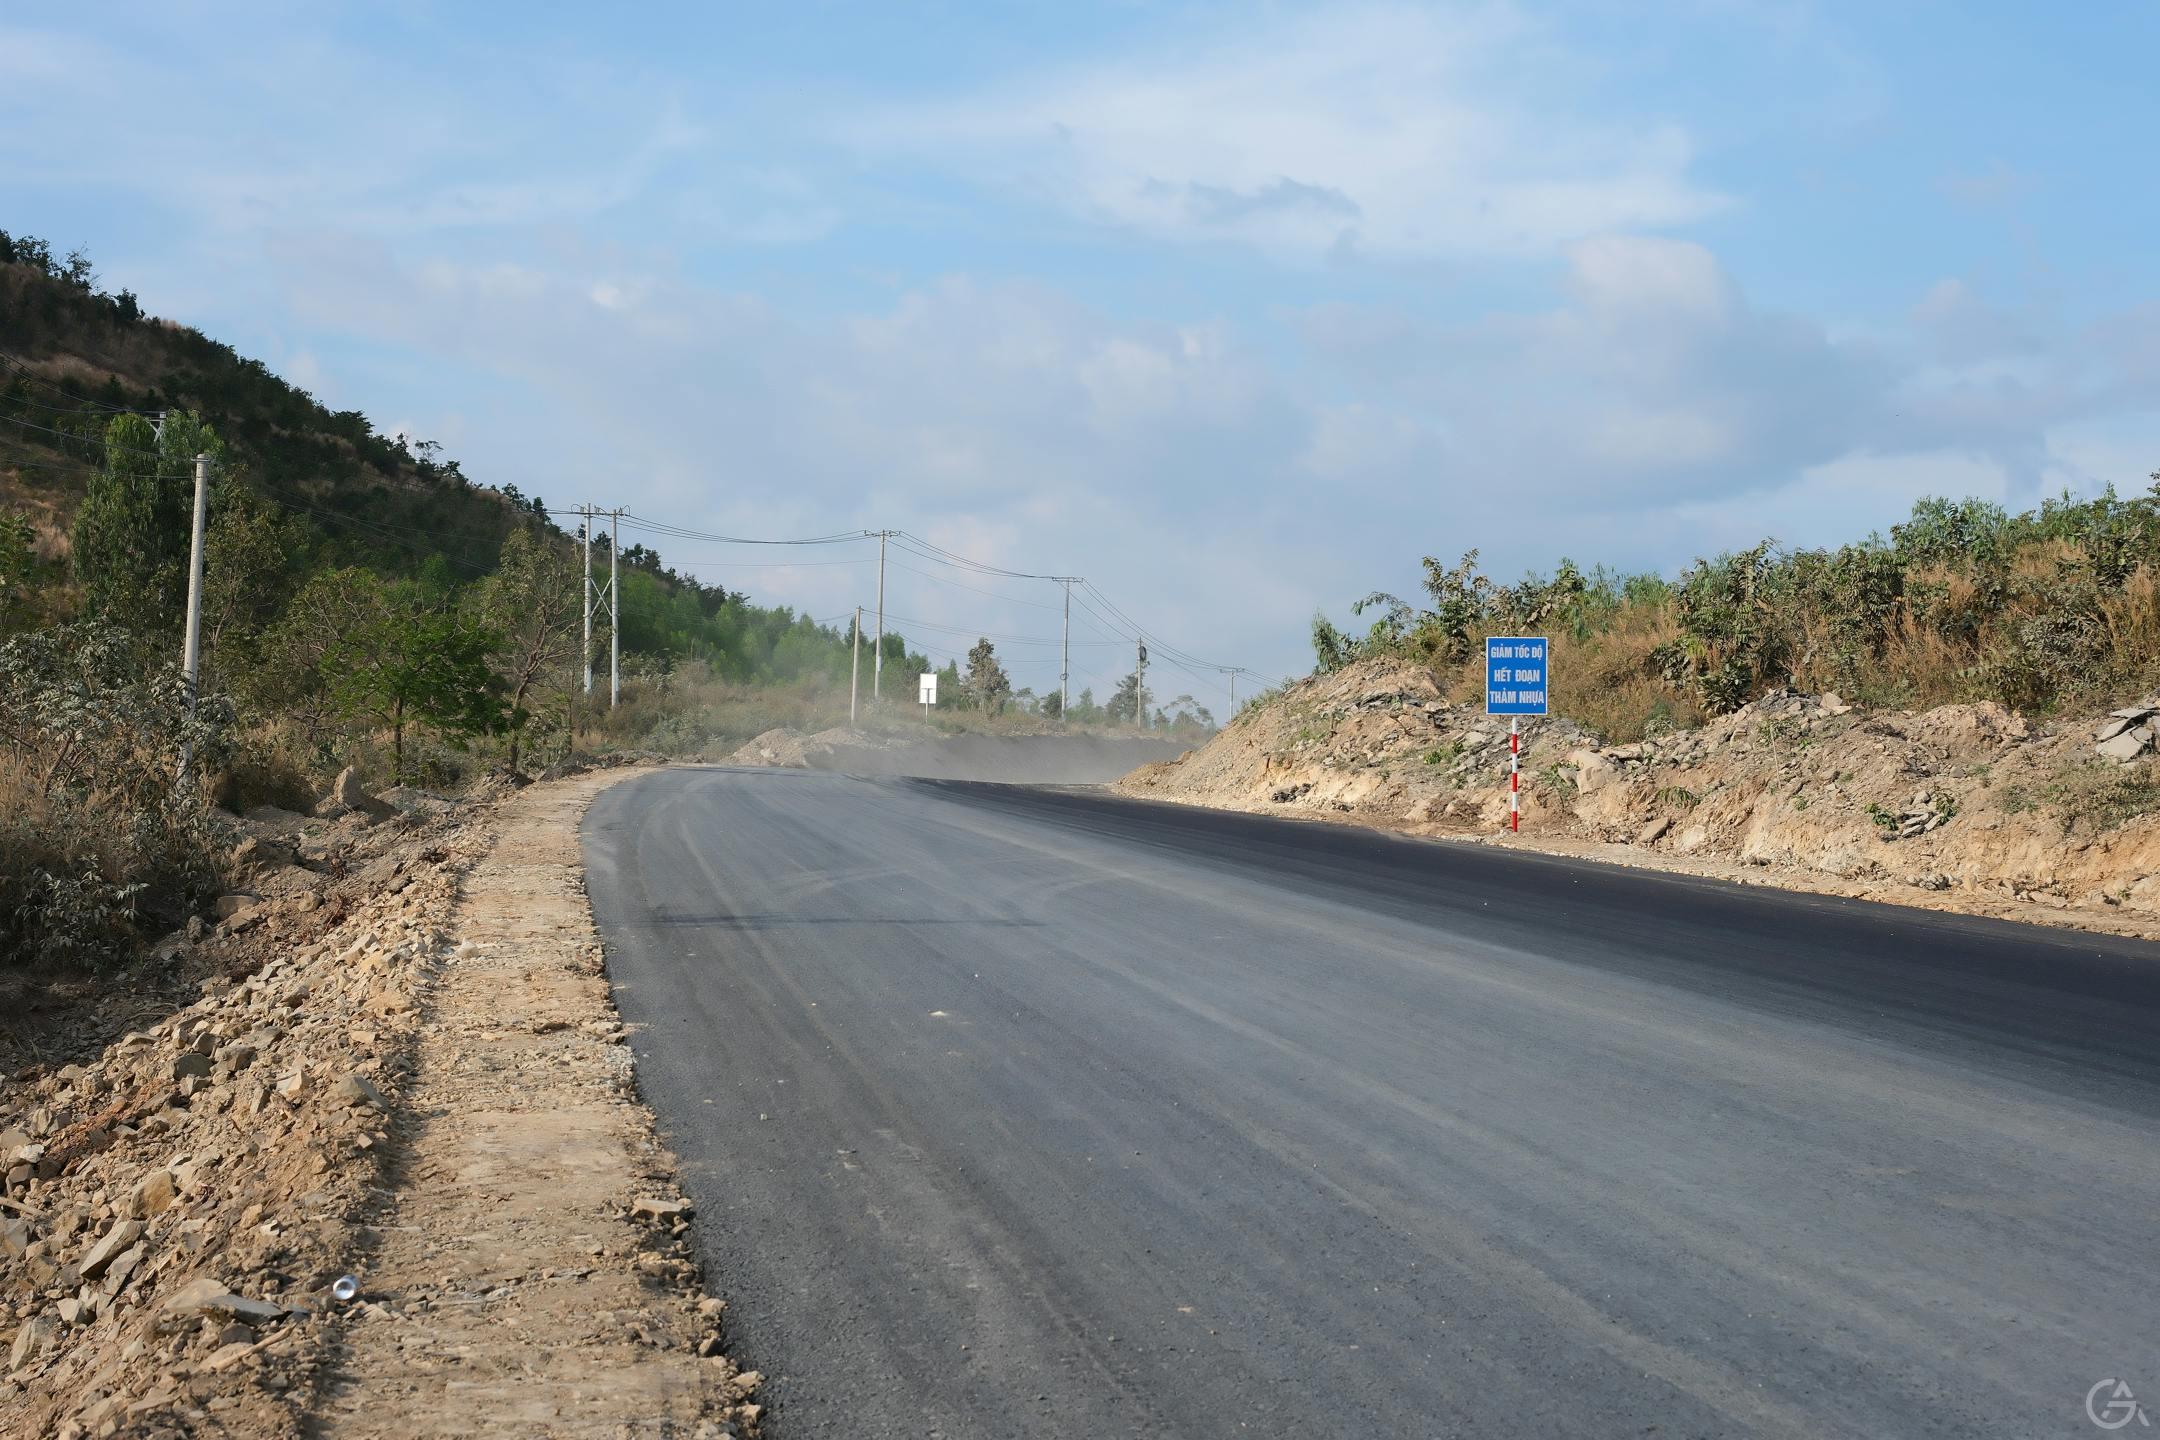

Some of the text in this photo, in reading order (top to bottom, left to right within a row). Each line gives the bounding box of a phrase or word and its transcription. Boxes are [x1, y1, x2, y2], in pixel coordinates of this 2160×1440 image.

[1491, 643, 1543, 661] GIẢM TỐC ĐỘ
[1494, 666, 1540, 684] HẾT ĐOẠN
[1490, 687, 1544, 706] THẢM NHỰA
